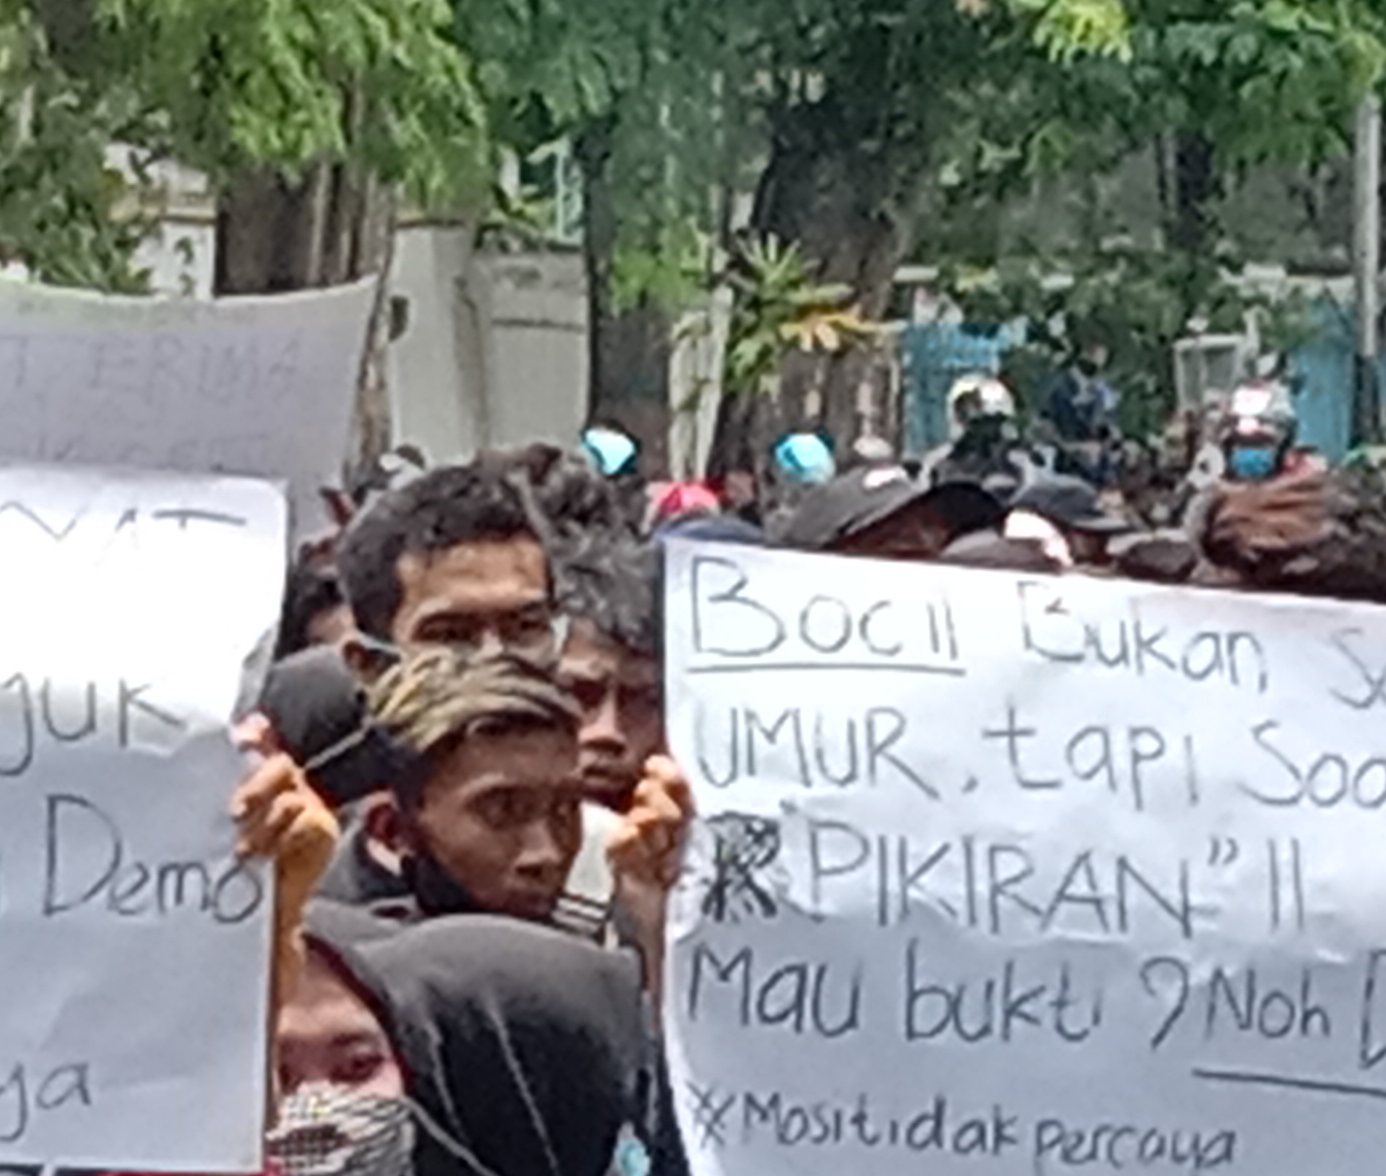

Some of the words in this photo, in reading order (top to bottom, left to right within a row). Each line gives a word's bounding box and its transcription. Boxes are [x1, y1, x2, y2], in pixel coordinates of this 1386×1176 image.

[981, 694, 1199, 812] tapi
[41, 795, 263, 923] Demo
[687, 942, 859, 1037] Mau
[904, 940, 1101, 1046] bukti
[1205, 965, 1333, 1040] Noh
